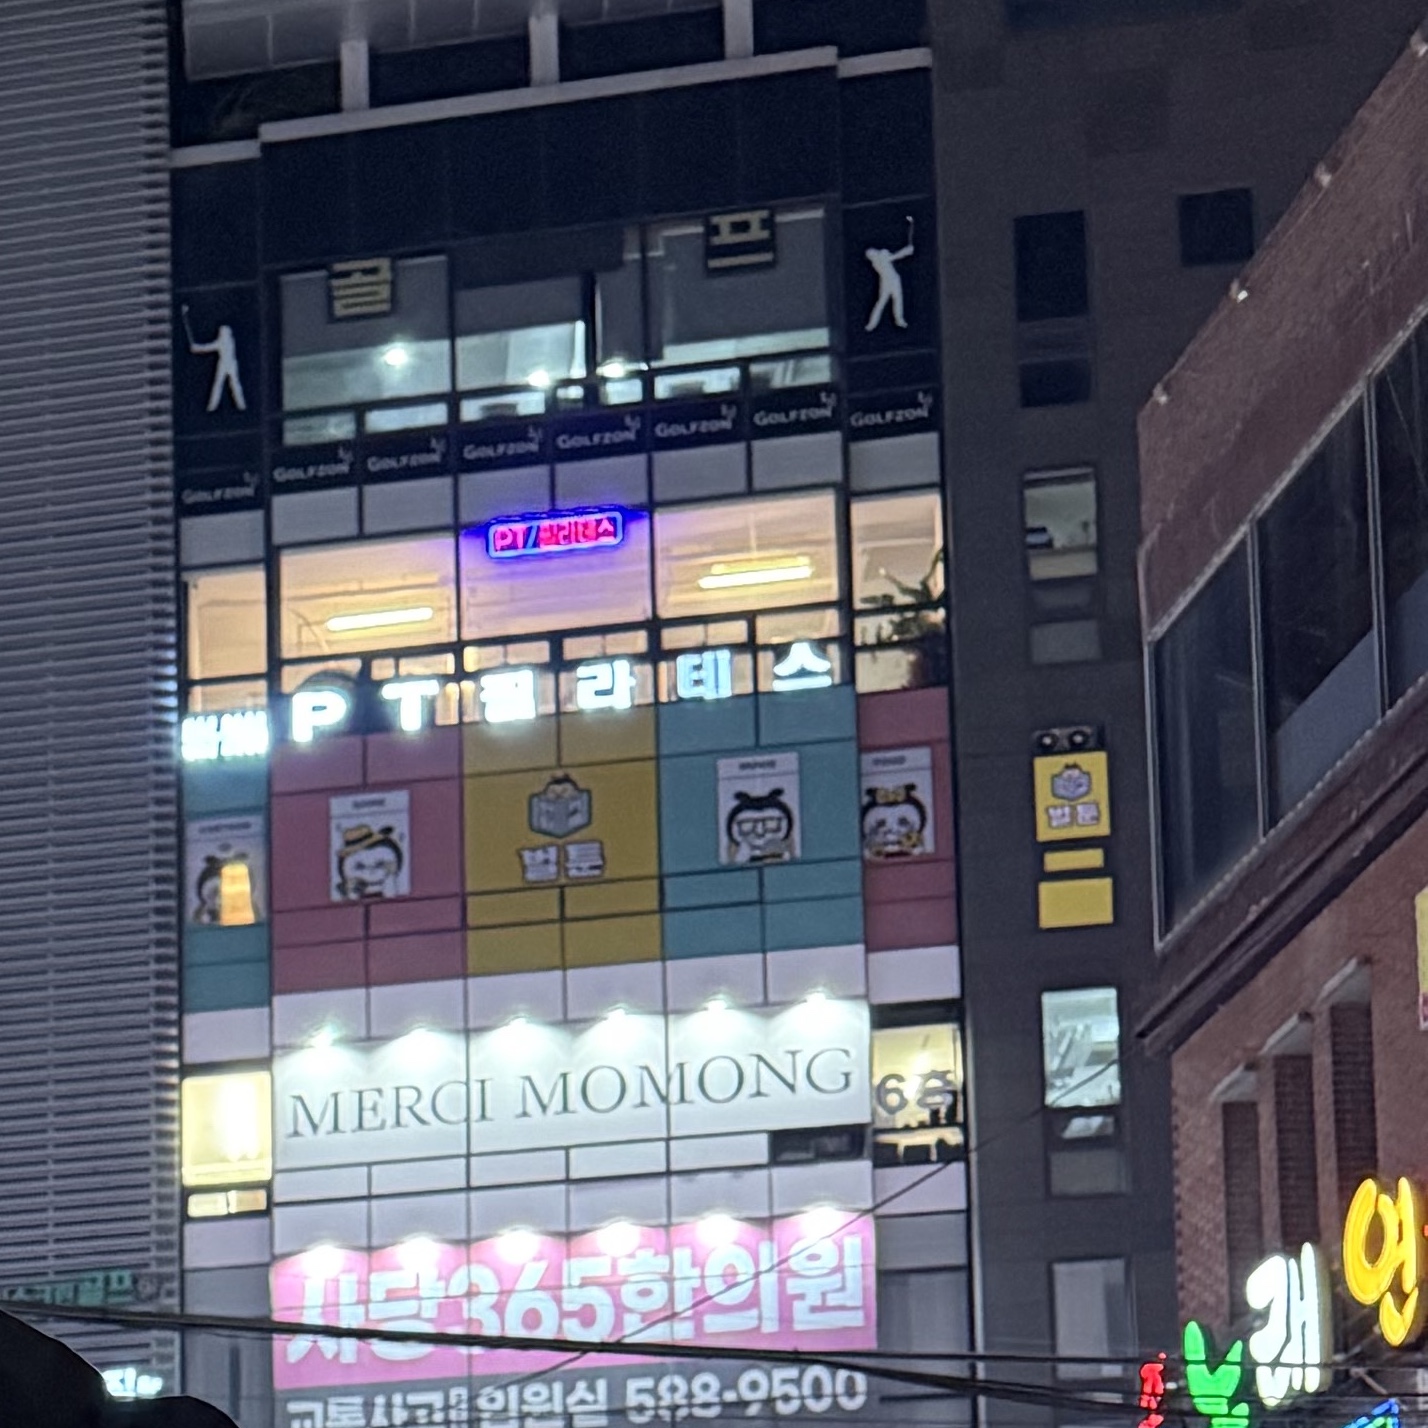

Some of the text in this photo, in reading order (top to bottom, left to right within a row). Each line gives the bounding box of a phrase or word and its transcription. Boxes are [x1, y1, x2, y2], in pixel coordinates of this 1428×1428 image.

[285, 1047, 853, 1139] MERCI MOMONG
[625, 1364, 868, 1424] 588-9500
